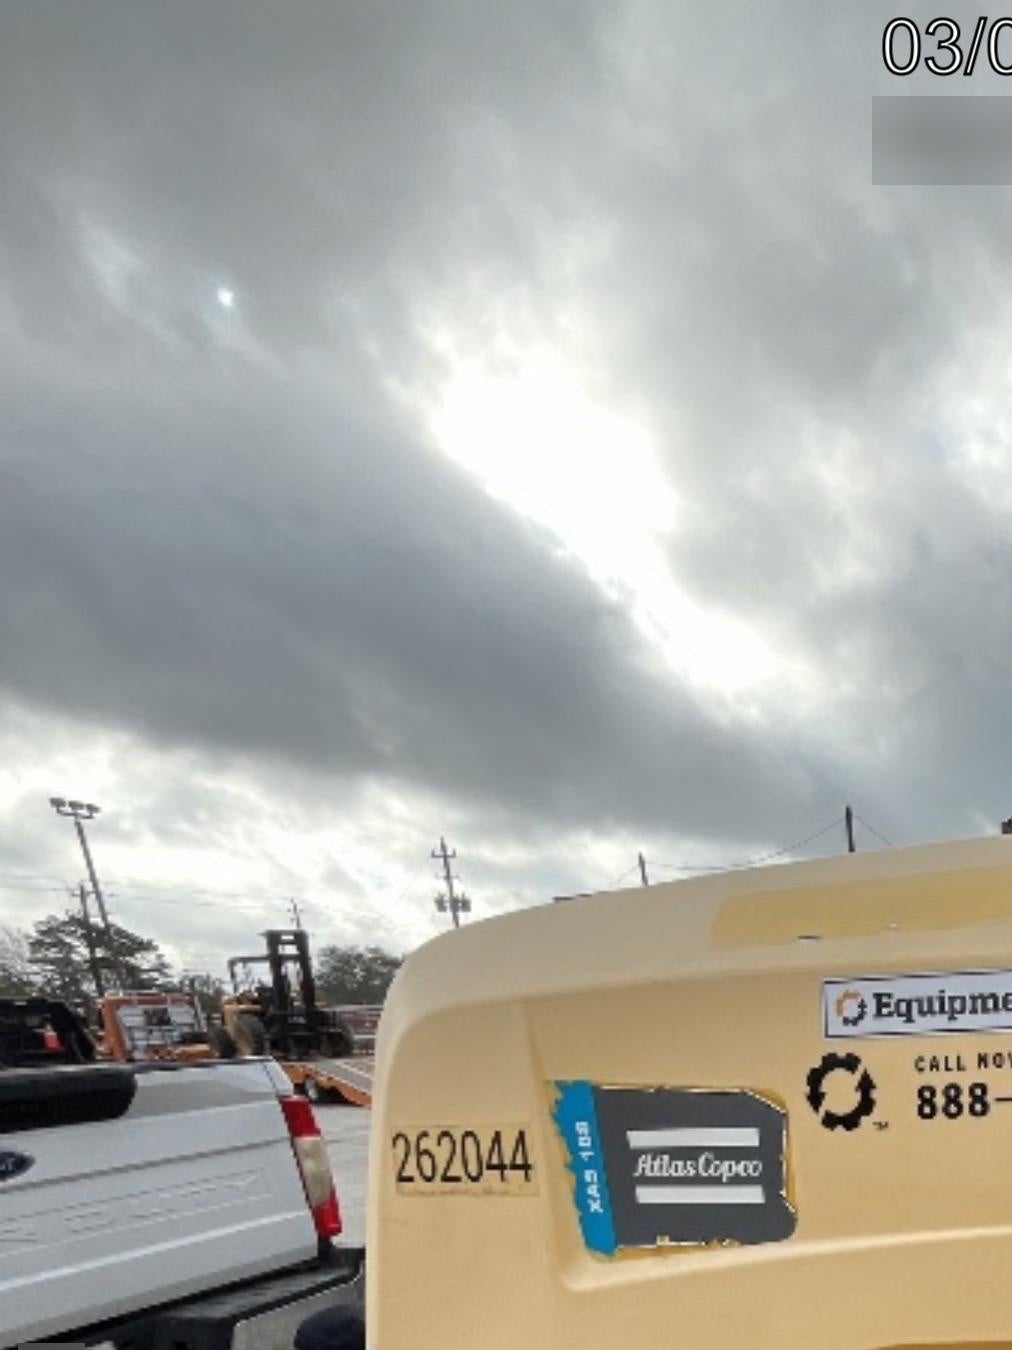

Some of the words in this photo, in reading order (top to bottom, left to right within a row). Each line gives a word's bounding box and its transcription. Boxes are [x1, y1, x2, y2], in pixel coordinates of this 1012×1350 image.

[914, 1055, 967, 1073] CALL
[391, 1129, 534, 1183] 262044
[633, 1152, 697, 1177] Atlas
[698, 1151, 763, 1183] Copco
[584, 1169, 604, 1213] XAS
